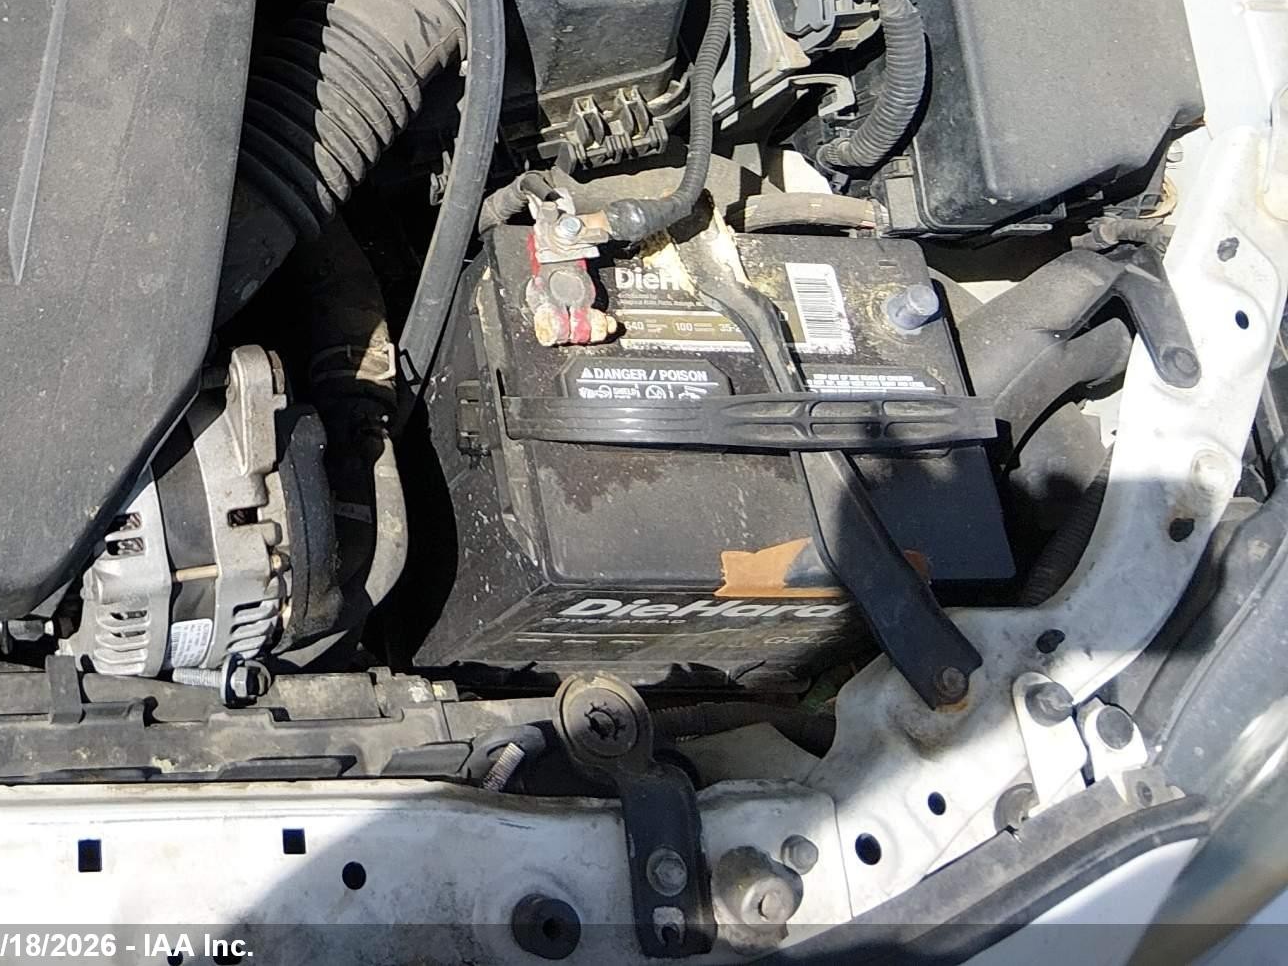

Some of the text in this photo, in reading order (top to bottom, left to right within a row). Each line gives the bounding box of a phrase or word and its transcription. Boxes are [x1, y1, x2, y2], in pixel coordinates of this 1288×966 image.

[615, 267, 681, 291] DieH
[675, 322, 694, 333] 100
[593, 368, 649, 380] DANGER
[659, 370, 708, 382] POISON
[560, 597, 850, 618] DieHard
